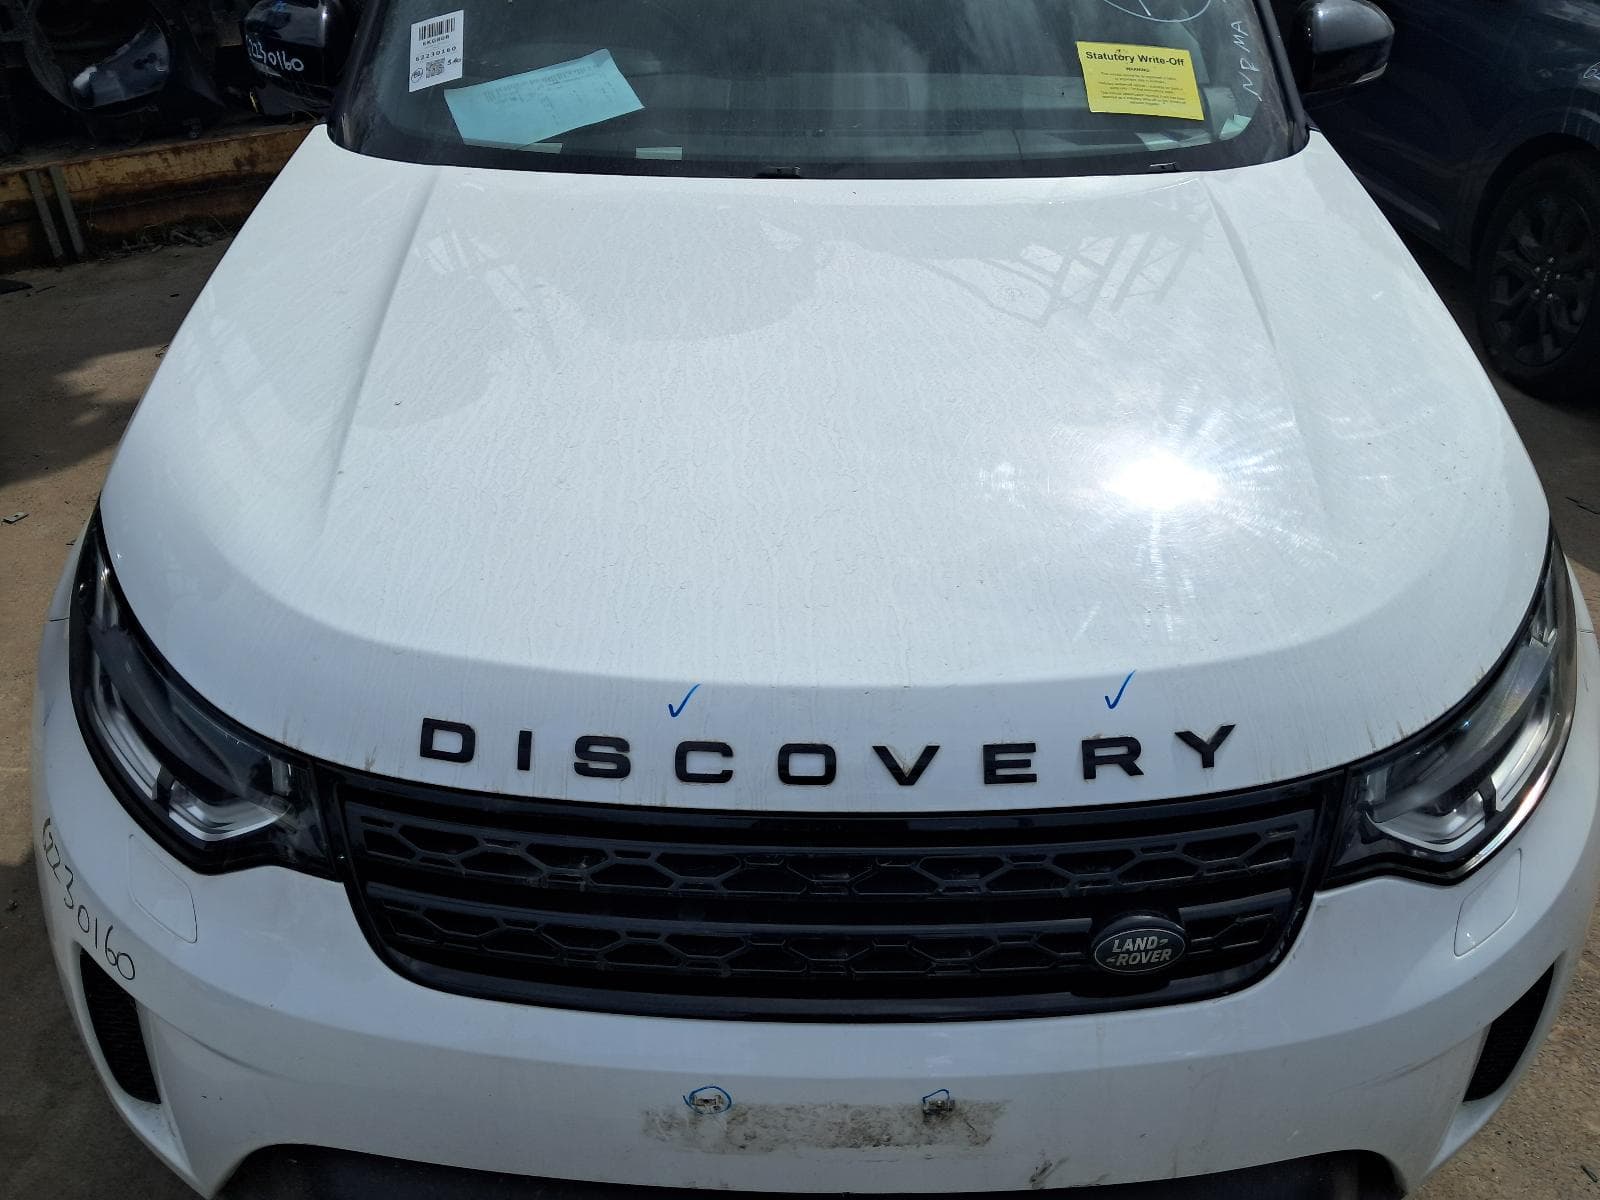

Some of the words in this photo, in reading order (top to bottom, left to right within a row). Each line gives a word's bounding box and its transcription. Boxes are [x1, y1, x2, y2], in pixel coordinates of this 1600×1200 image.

[1085, 51, 1135, 65] Statutory
[1137, 54, 1185, 68] Write-Off
[420, 717, 1236, 786] DISCOVERY
